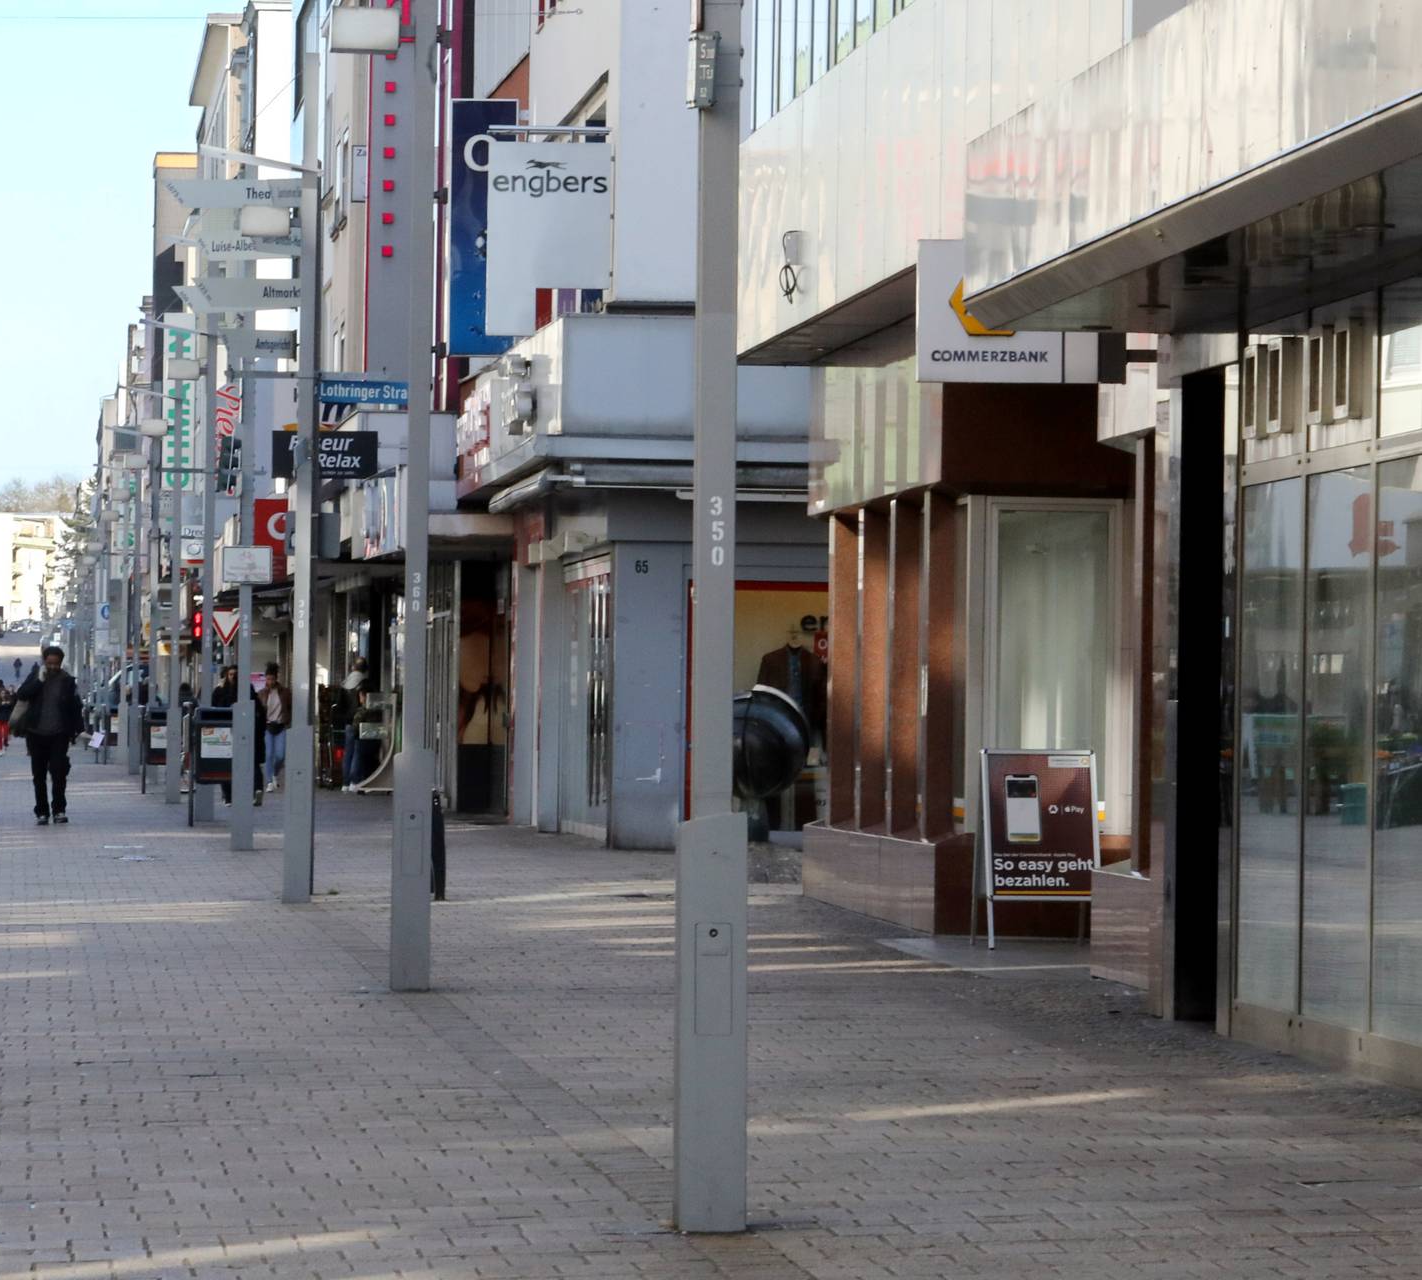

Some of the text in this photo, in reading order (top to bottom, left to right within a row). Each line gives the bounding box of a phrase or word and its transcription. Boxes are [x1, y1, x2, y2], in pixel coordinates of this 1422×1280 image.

[493, 170, 608, 197] engbers
[246, 187, 272, 200] Thea
[211, 241, 256, 253] Luise-Albe
[931, 349, 1049, 363] COMMERZBANK
[320, 383, 408, 401] Lothringer Stra
[289, 435, 354, 451] Feur
[318, 453, 361, 468] Relax
[709, 496, 726, 567] 350
[635, 560, 649, 575] 65
[412, 572, 421, 612] 360
[994, 858, 1093, 873] So easy geht
[994, 874, 1070, 887] bezahlen.
